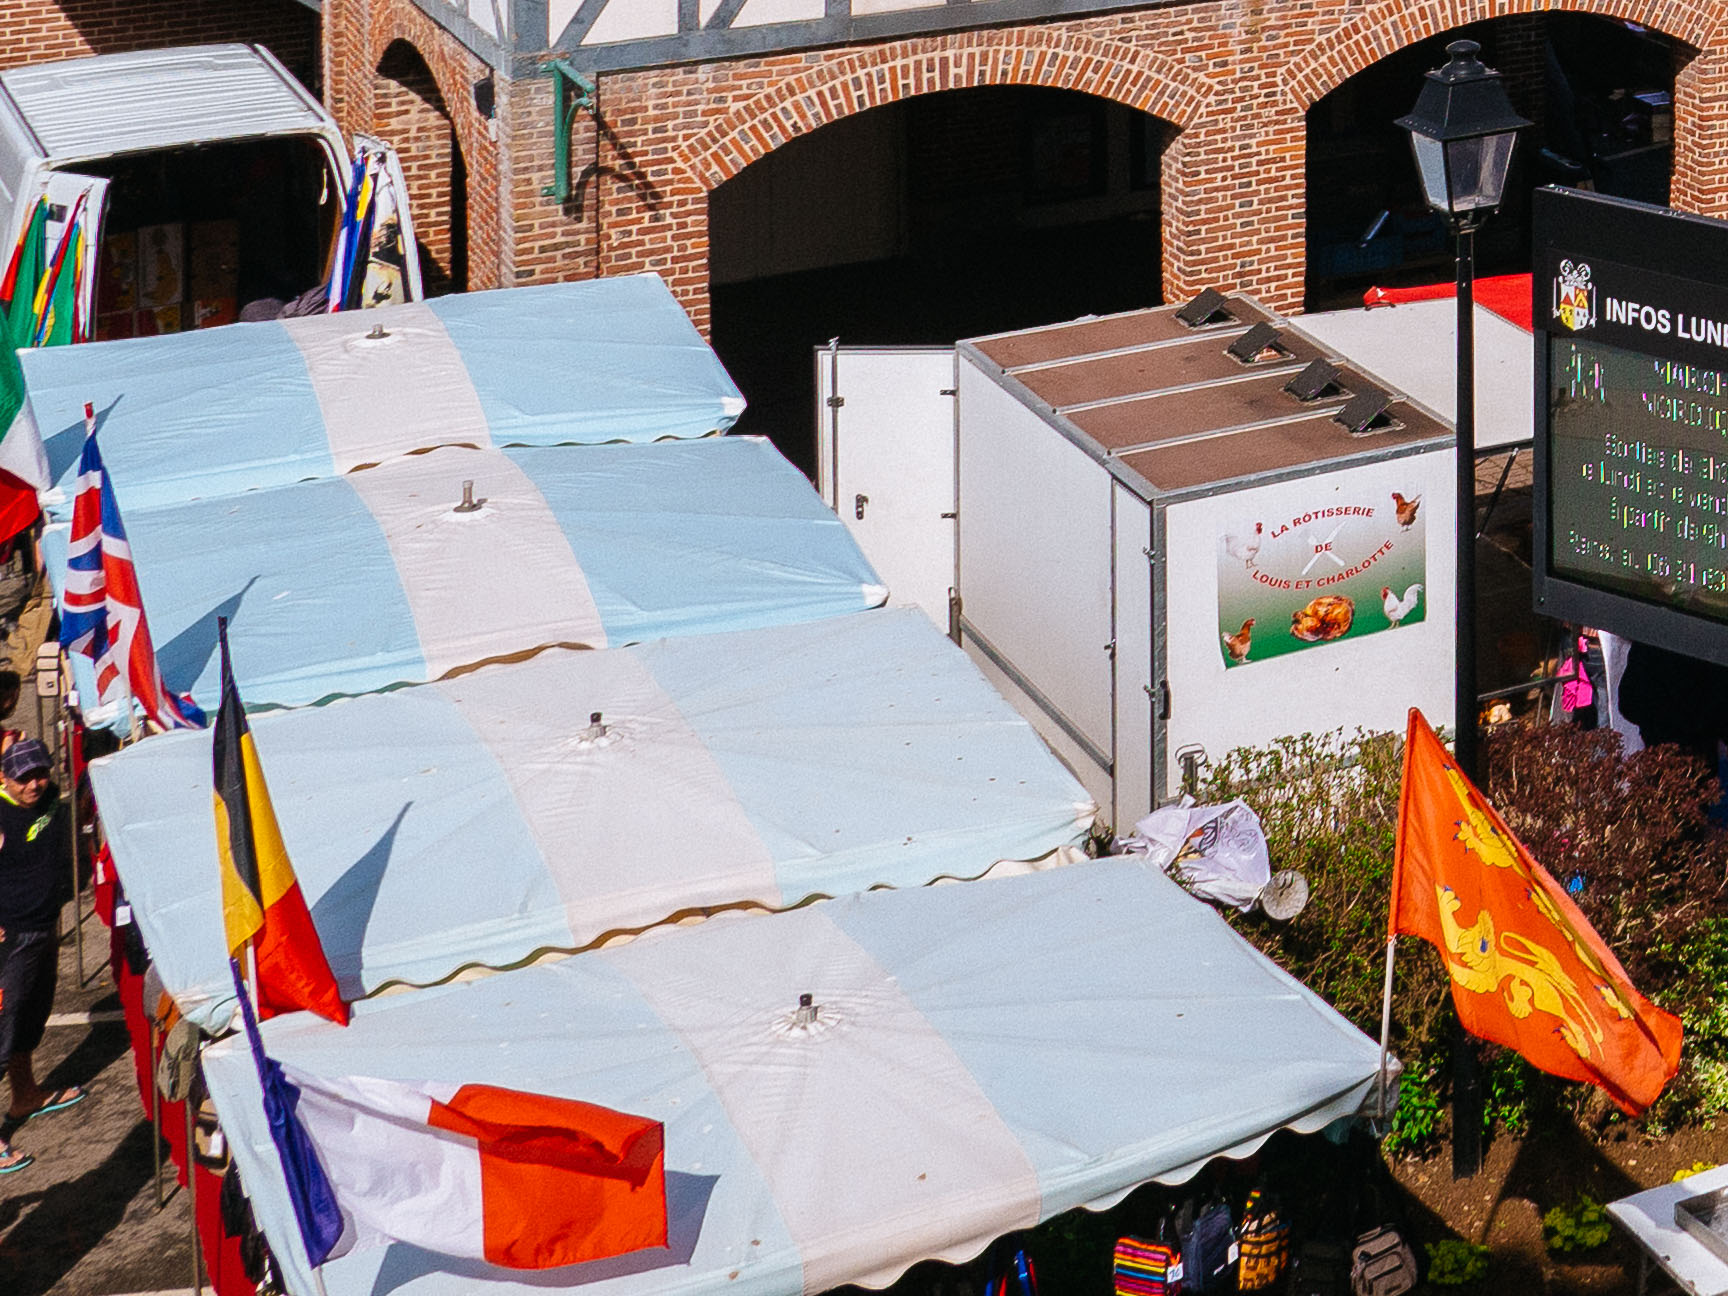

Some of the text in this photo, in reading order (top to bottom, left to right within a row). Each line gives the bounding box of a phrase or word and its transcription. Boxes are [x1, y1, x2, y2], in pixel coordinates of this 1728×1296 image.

[1606, 297, 1671, 335] INFOS
[1270, 523, 1290, 540] LA
[1313, 540, 1333, 555] DE
[1251, 539, 1395, 590] LOUIS ET CHARLOTTE
